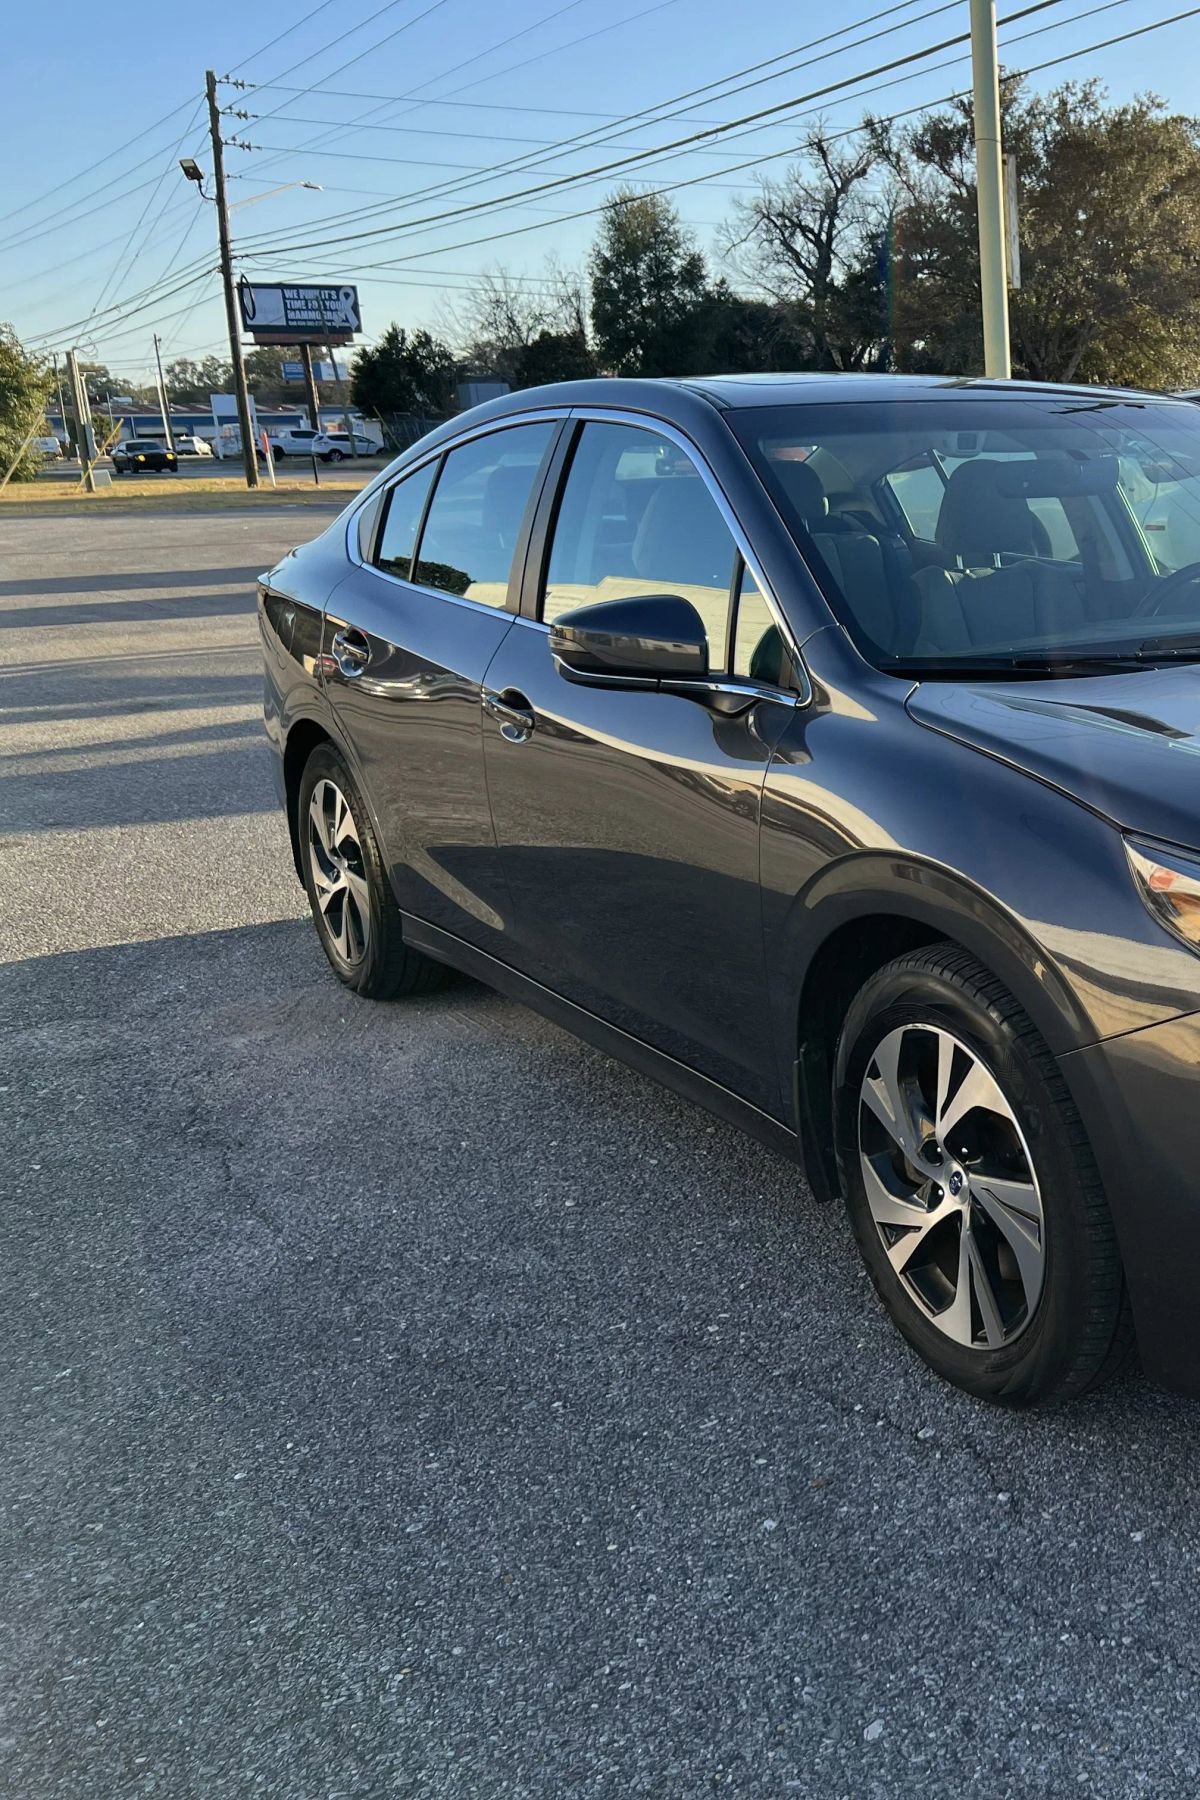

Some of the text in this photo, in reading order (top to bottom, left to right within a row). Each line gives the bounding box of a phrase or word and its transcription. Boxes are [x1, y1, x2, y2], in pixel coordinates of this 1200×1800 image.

[283, 289, 298, 298] WE
[321, 290, 337, 299] IT'S
[285, 300, 306, 309] TIME
